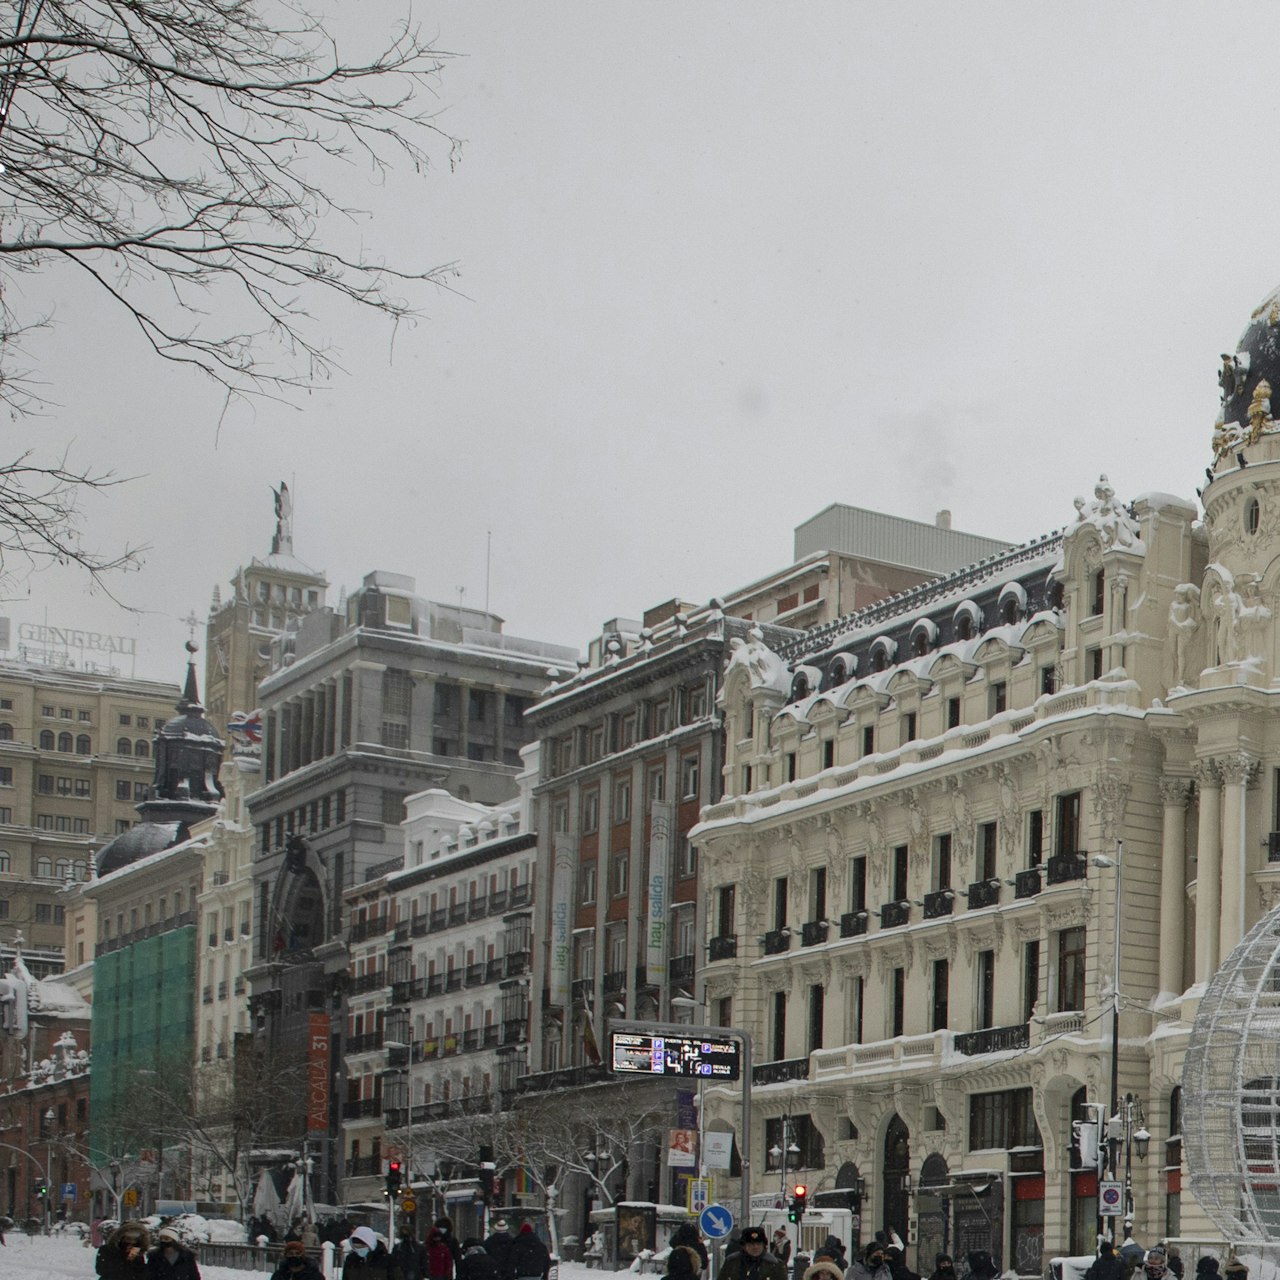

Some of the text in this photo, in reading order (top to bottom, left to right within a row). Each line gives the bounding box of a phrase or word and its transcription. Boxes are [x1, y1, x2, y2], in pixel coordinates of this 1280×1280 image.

[19, 623, 137, 655] GENERALI
[553, 902, 567, 943] salida
[649, 875, 665, 949] hay salida
[312, 1035, 328, 1051] 31
[752, 1199, 773, 1208] OUTLET
